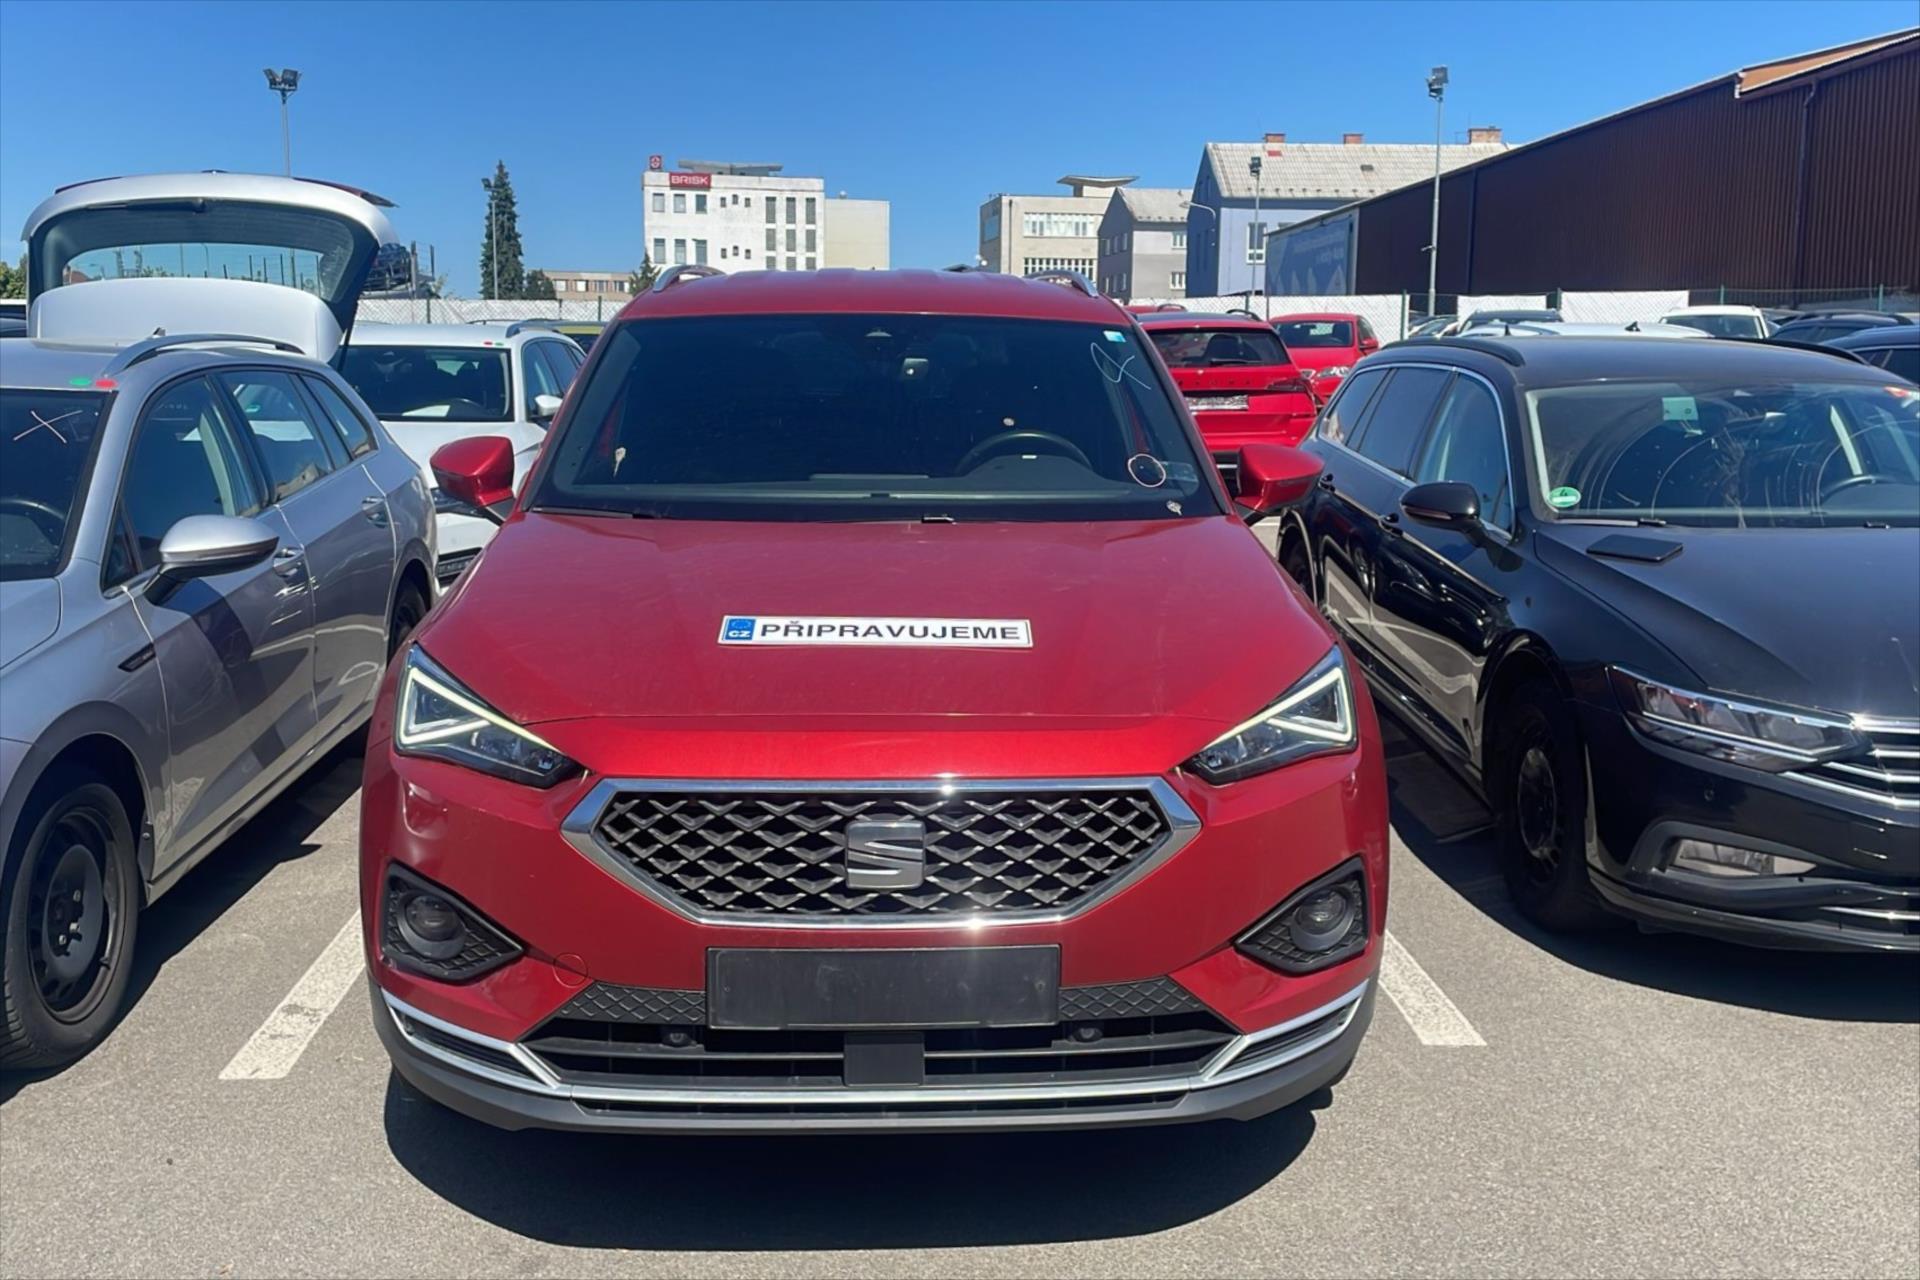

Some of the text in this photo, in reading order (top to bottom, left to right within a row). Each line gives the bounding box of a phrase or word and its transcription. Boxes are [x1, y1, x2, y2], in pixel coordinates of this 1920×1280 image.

[671, 175, 708, 185] BRISK
[728, 620, 1020, 640] CZ PŘIPRAVUJEME
